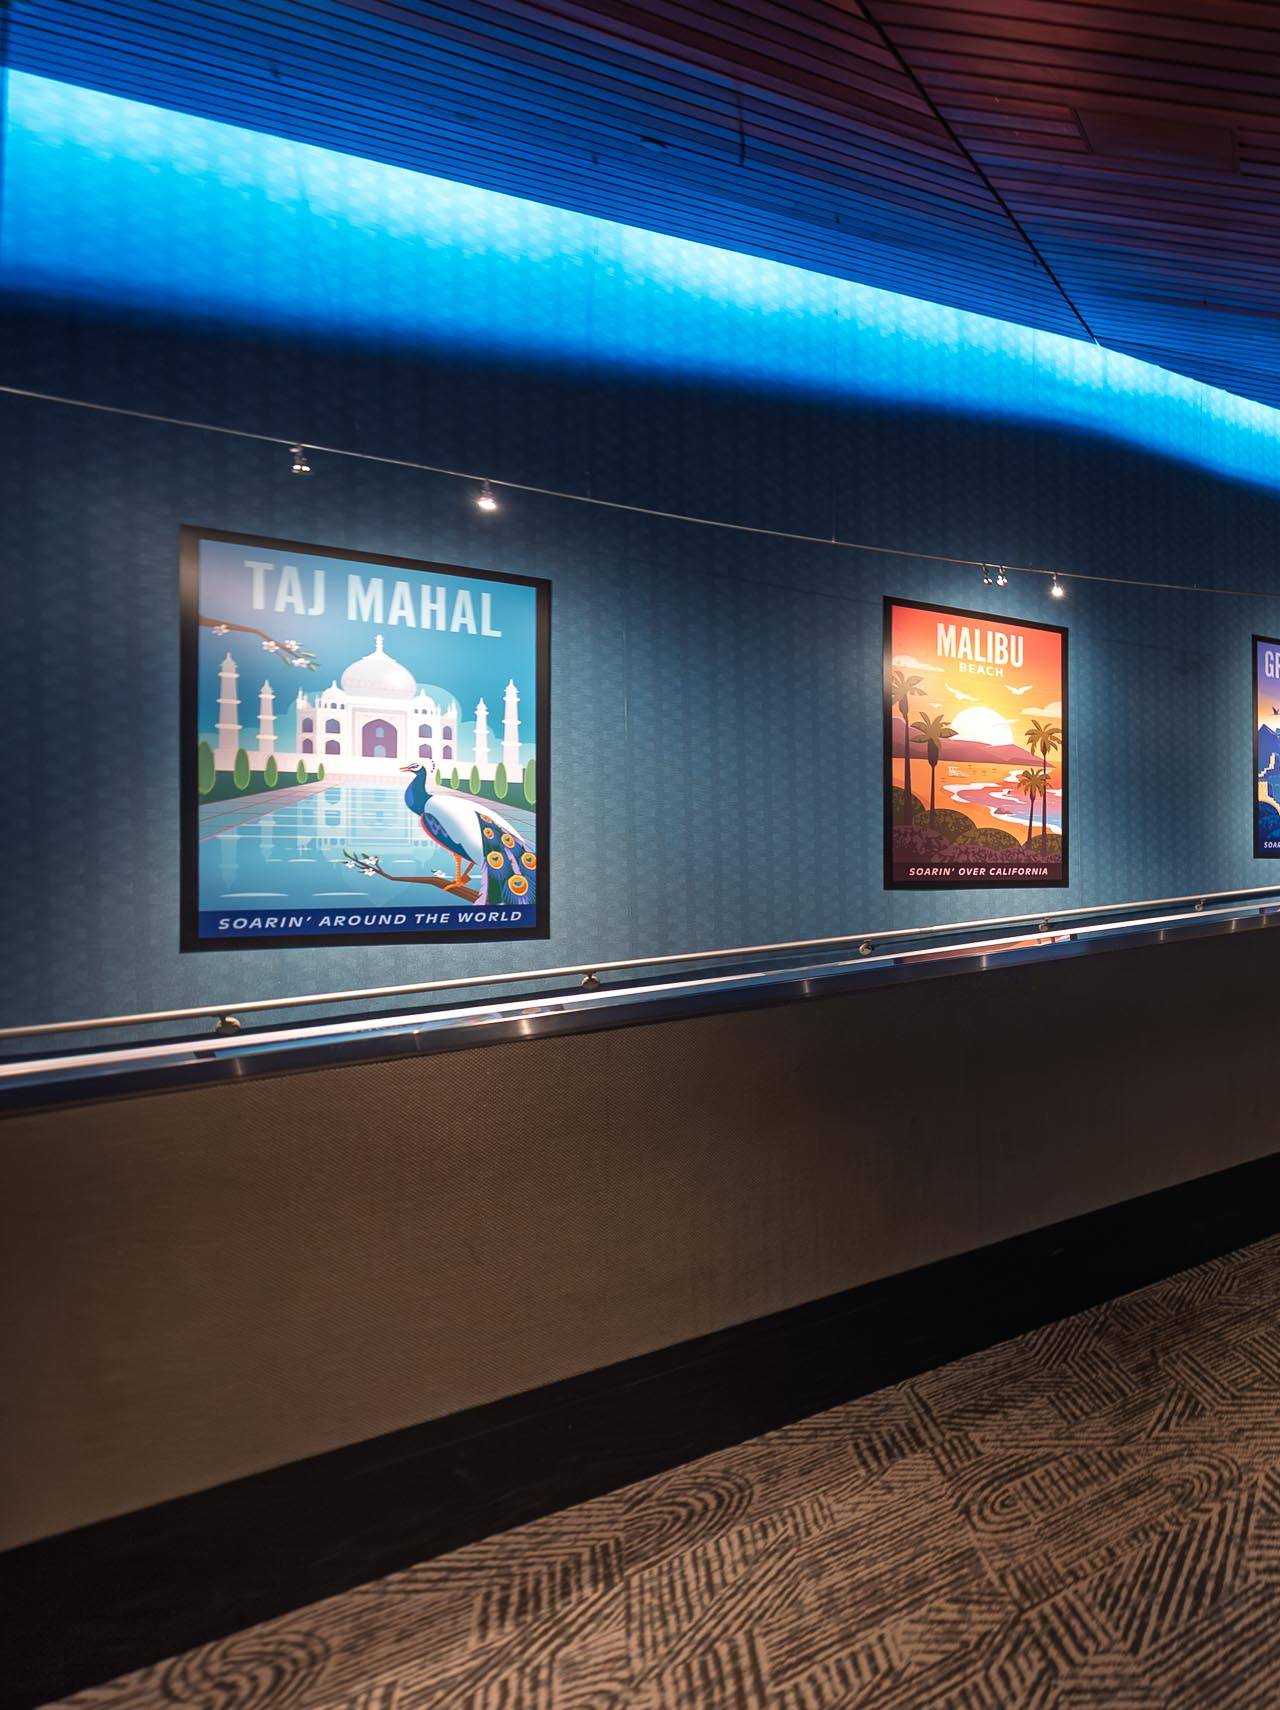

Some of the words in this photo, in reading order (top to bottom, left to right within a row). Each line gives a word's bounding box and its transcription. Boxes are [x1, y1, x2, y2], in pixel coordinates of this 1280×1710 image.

[243, 560, 325, 616] TAJ
[347, 574, 502, 638] MAHAL
[936, 622, 1024, 668] MALIBU
[959, 662, 1004, 678] BEACH
[908, 867, 955, 876] SOARIN'
[958, 867, 986, 876] OVER
[989, 867, 1049, 876] CALIFORNIA
[217, 915, 312, 930] SOARIN'
[318, 914, 407, 927] AROUND
[415, 912, 450, 924] THE
[457, 910, 523, 923] WORLD
